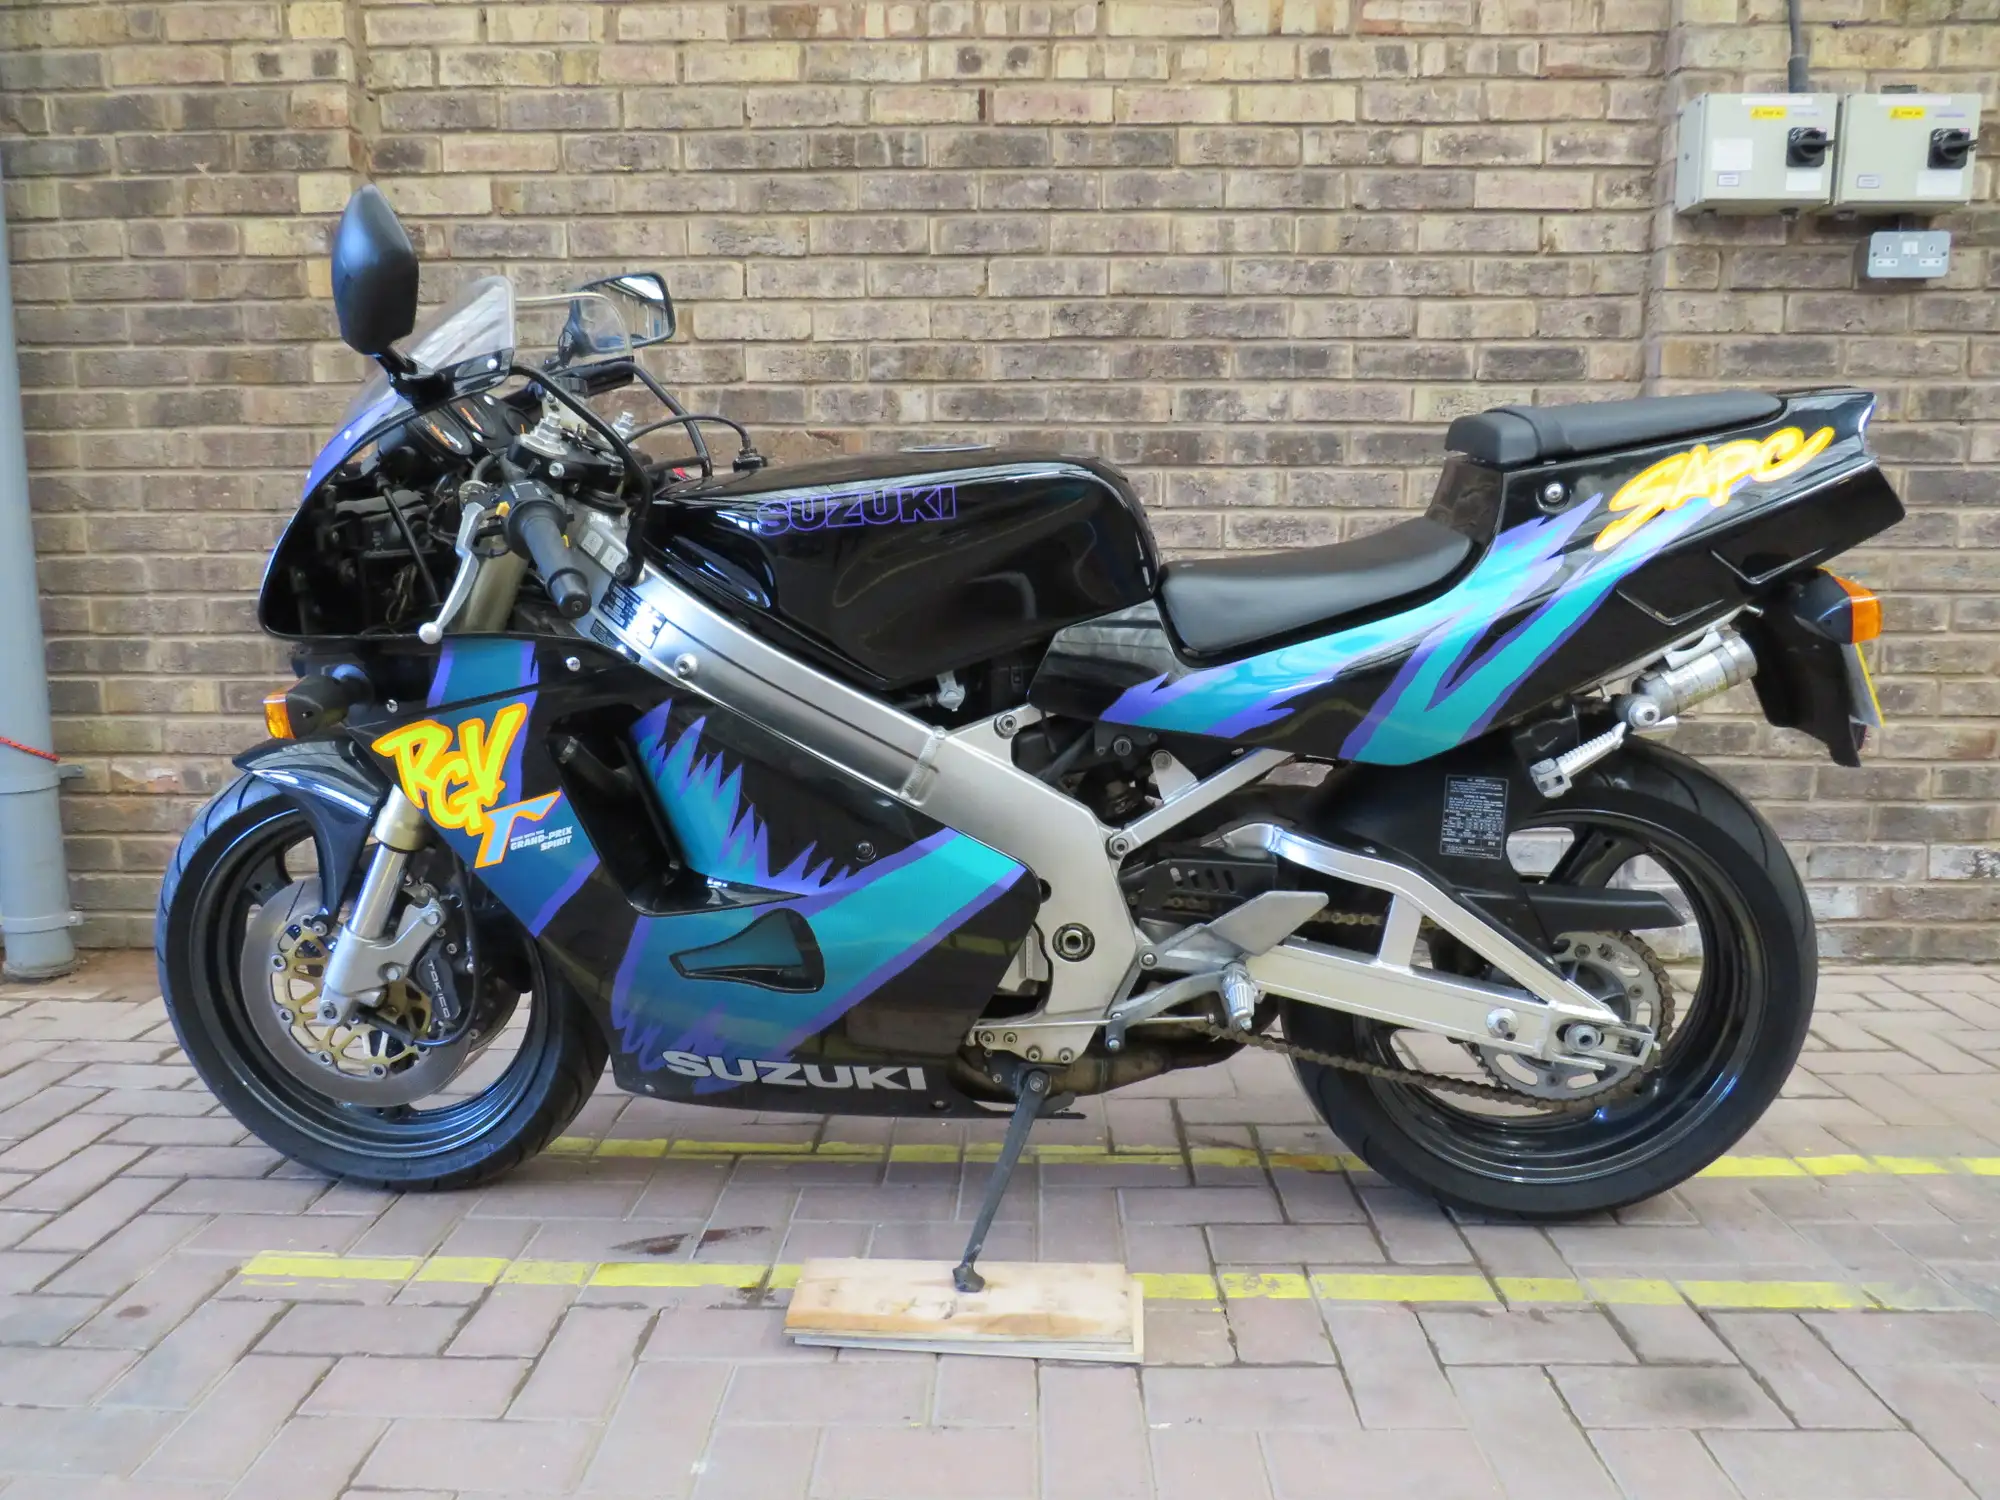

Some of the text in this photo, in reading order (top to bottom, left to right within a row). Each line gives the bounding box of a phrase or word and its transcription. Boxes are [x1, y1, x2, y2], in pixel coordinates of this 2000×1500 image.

[757, 485, 956, 536] SUZUKI
[510, 826, 573, 851] GRAND-PRIX
[540, 835, 573, 851] SPIRIT
[428, 959, 450, 1018] TOKICO
[662, 1050, 927, 1090] SUZUKI
